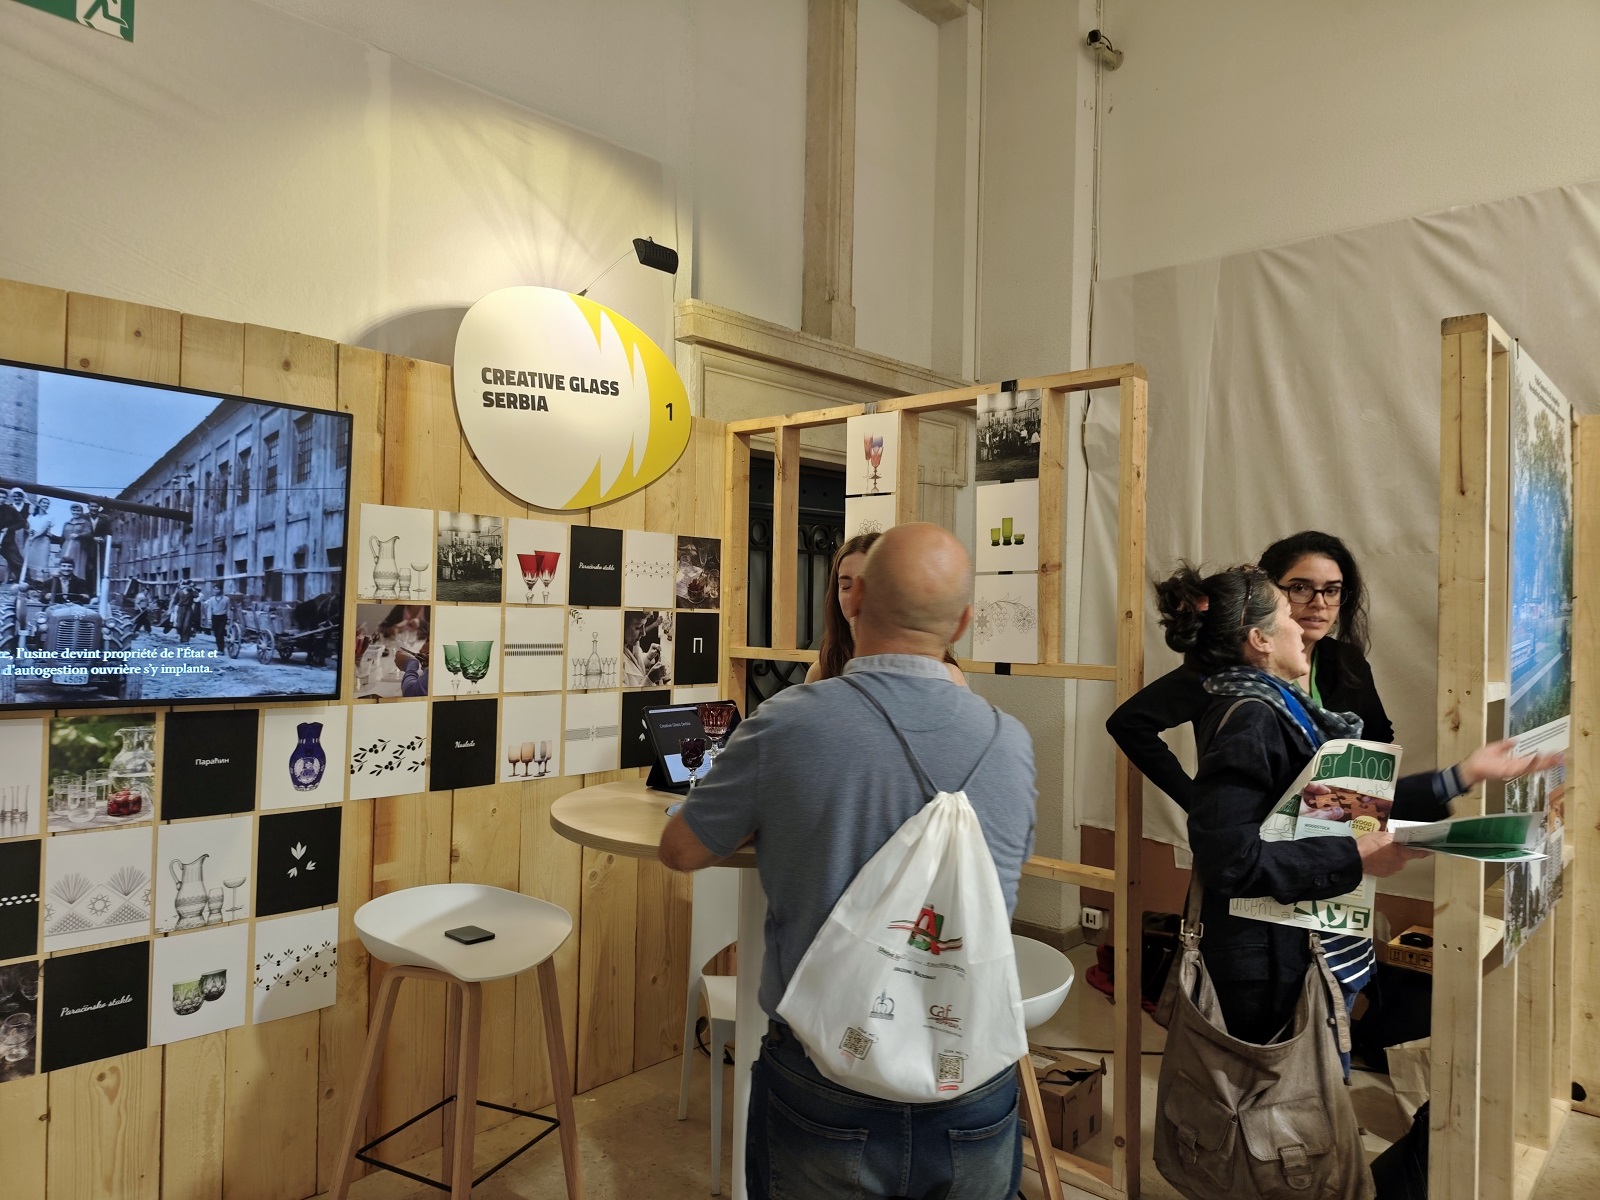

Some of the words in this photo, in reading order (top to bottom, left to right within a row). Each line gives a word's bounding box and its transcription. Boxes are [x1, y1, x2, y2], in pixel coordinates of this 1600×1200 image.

[481, 367, 565, 391] CREATIVE
[569, 376, 620, 397] GLASS
[482, 391, 549, 412] SERBIA
[665, 402, 673, 421] 1
[16, 648, 58, 659] l'usine
[61, 648, 101, 659] devint
[103, 648, 158, 662] propriété
[160, 648, 175, 659] de
[177, 647, 205, 659] l'État
[207, 649, 219, 659] et
[2, 664, 89, 679] d'autogestion
[91, 664, 141, 675] ouvrière
[143, 664, 160, 677] s'y
[161, 663, 214, 677] implanta.
